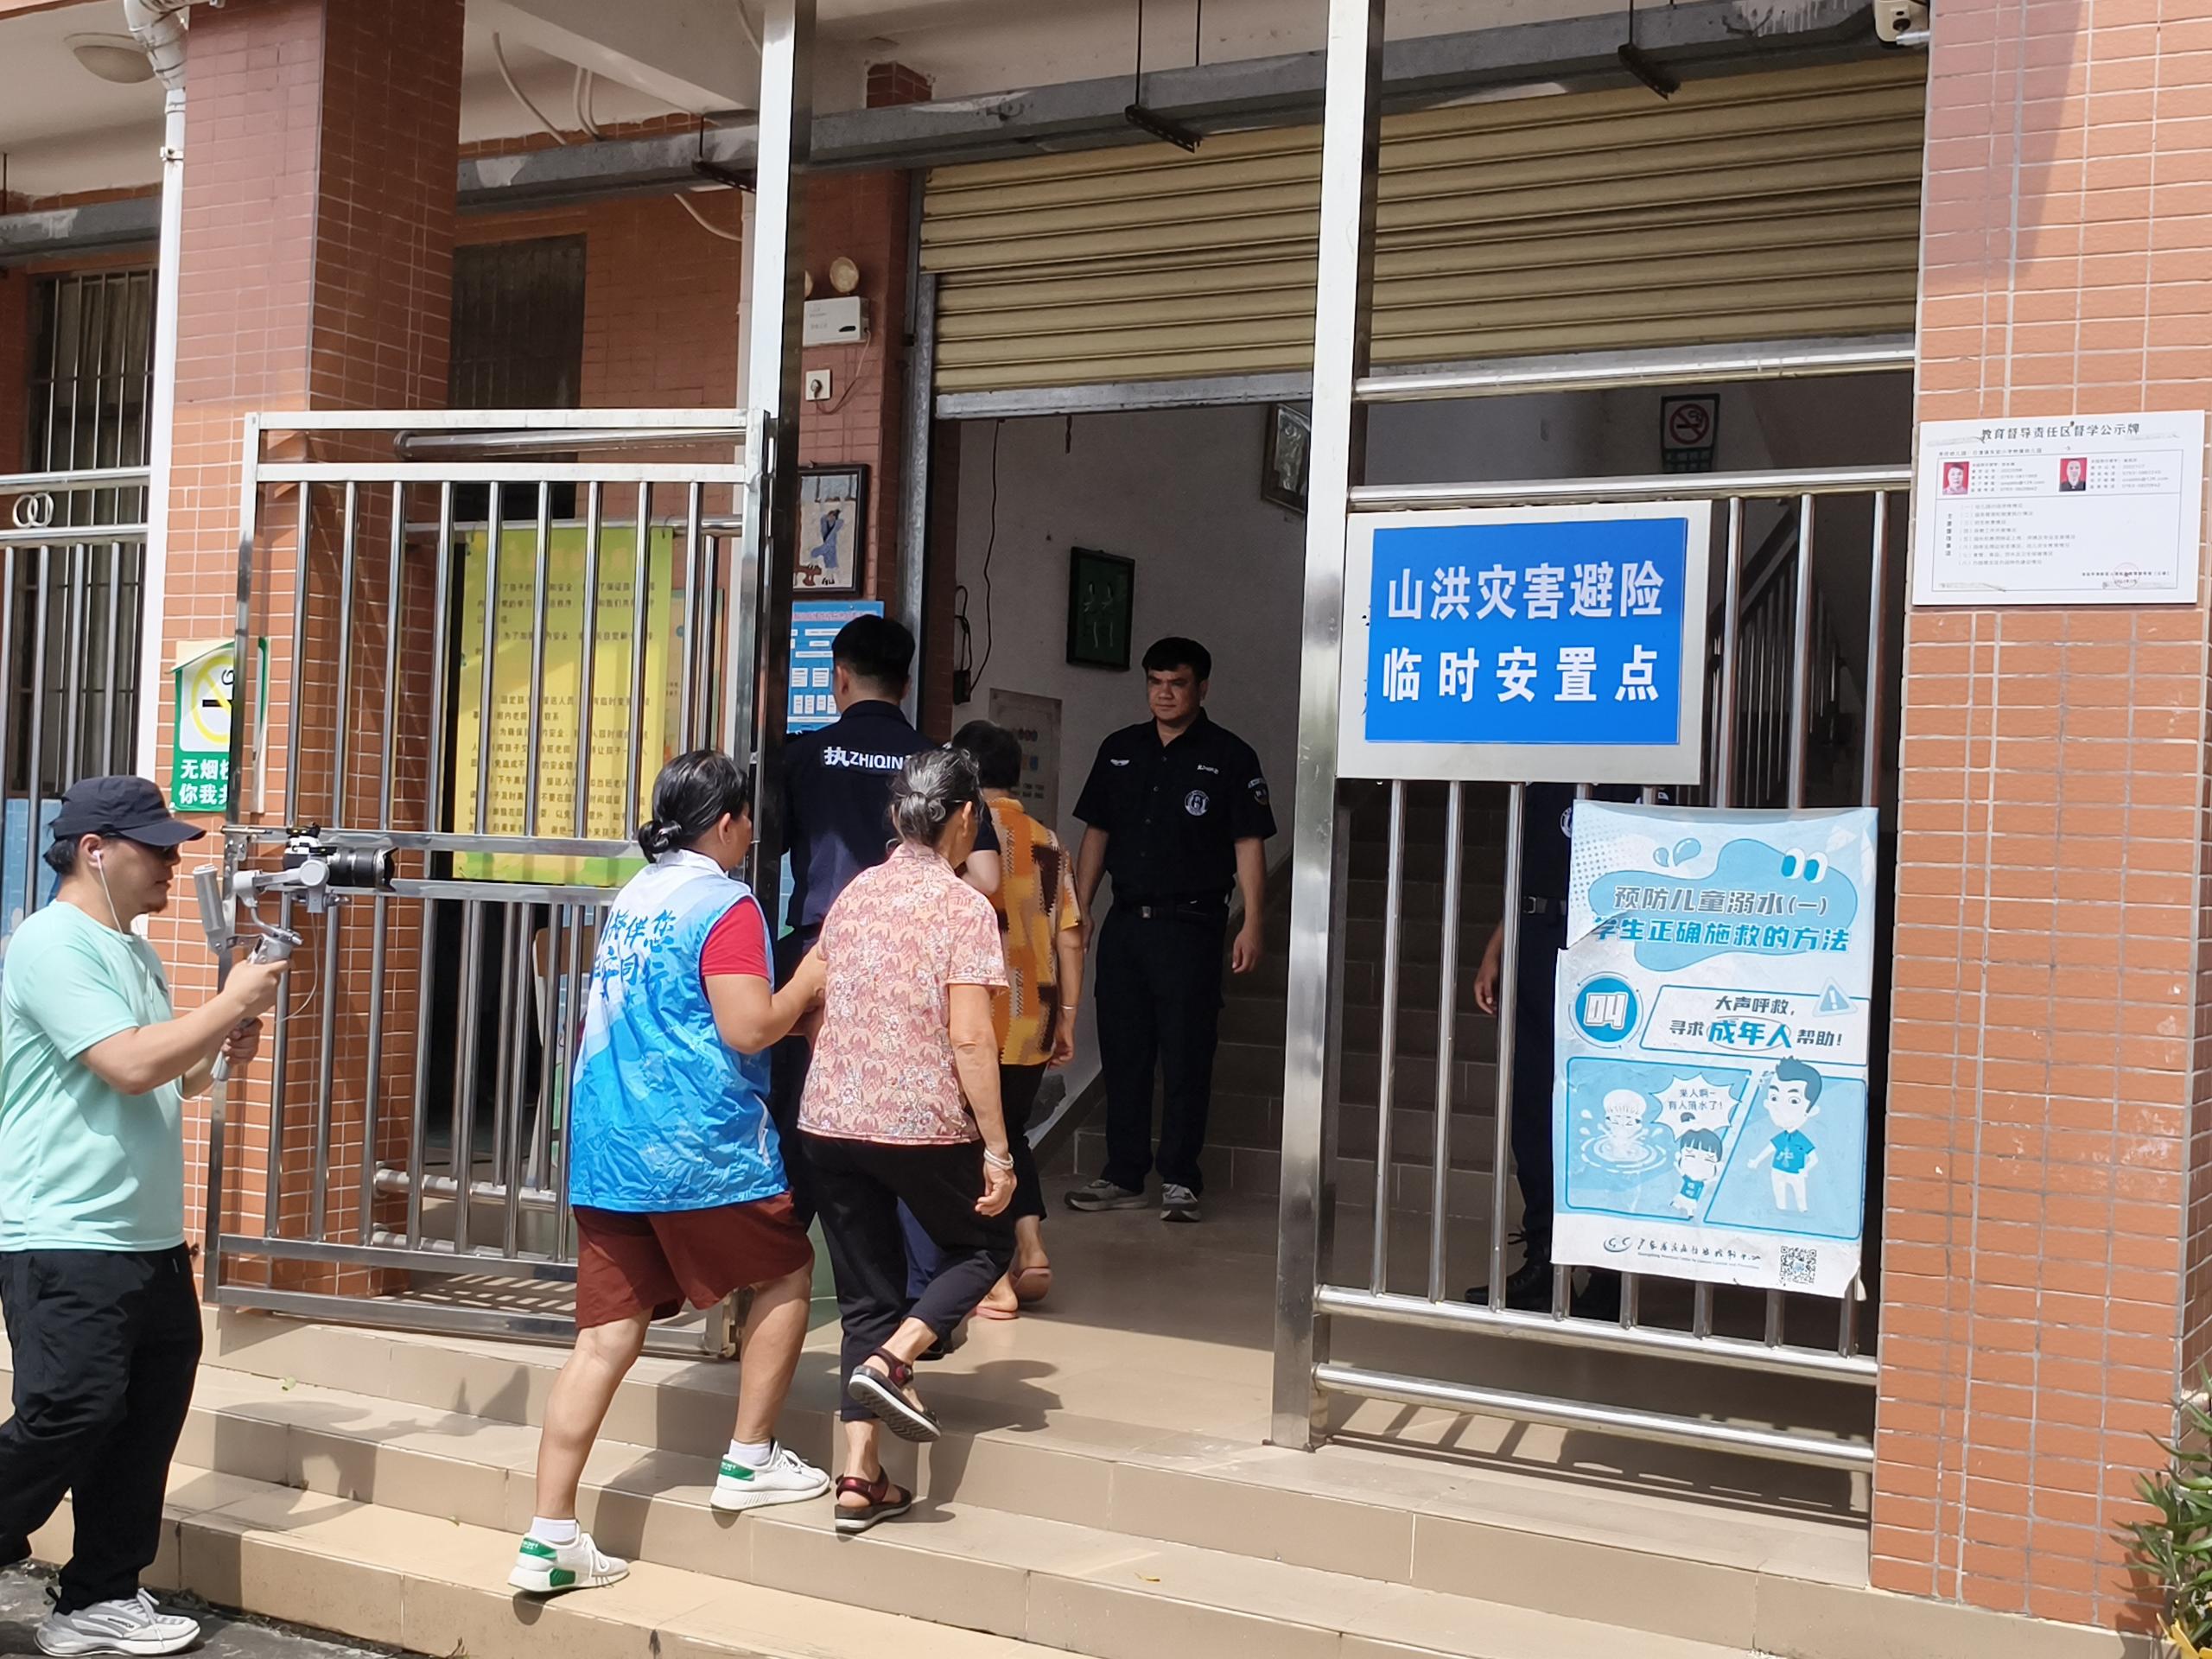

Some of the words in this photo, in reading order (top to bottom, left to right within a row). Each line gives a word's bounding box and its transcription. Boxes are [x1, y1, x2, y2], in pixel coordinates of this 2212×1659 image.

[1981, 423, 2140, 440] 教育督导责任区督学公示牌
[1387, 560, 1665, 620] 山洪灾害避险
[1382, 645, 1660, 702] 临时安置点
[823, 747, 912, 770] 执ZHIQIN
[1614, 886, 1827, 916] 预防儿童溺水(一)
[1593, 916, 1849, 951] 学生正确施救的方法
[1584, 994, 1628, 1030] 叫
